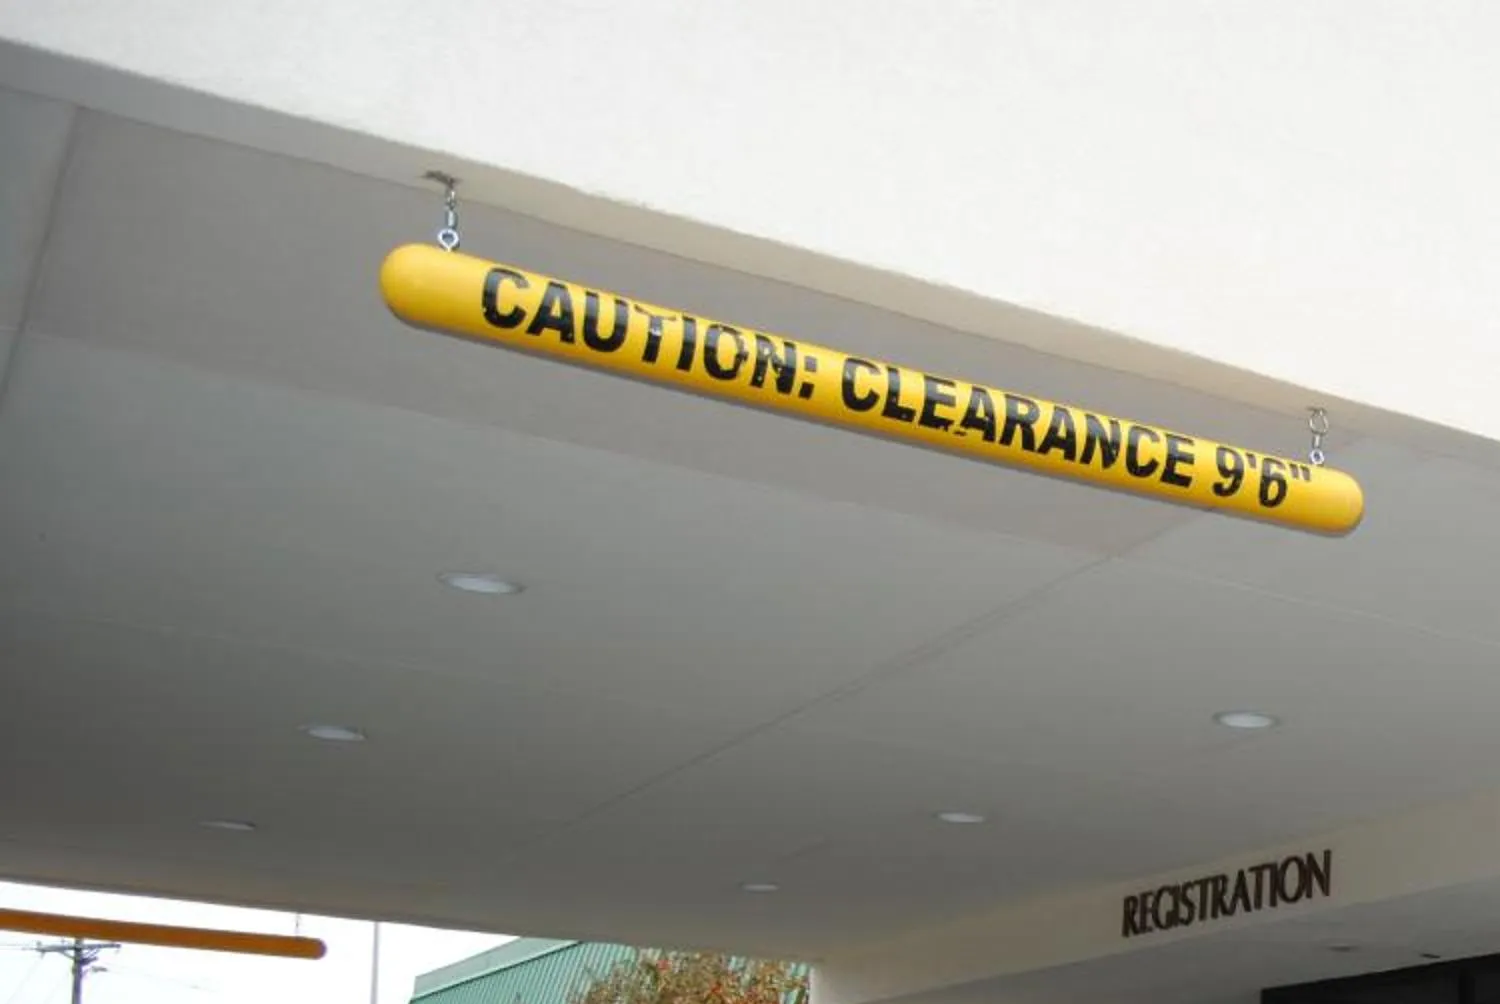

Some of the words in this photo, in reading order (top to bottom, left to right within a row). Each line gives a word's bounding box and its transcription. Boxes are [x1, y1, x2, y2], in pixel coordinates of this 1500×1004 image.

[481, 267, 817, 399] CAUTION:
[841, 357, 1195, 488] CLEARANCE
[1212, 446, 1311, 508] 9'6"
[1122, 849, 1332, 938] REGISTRATION
